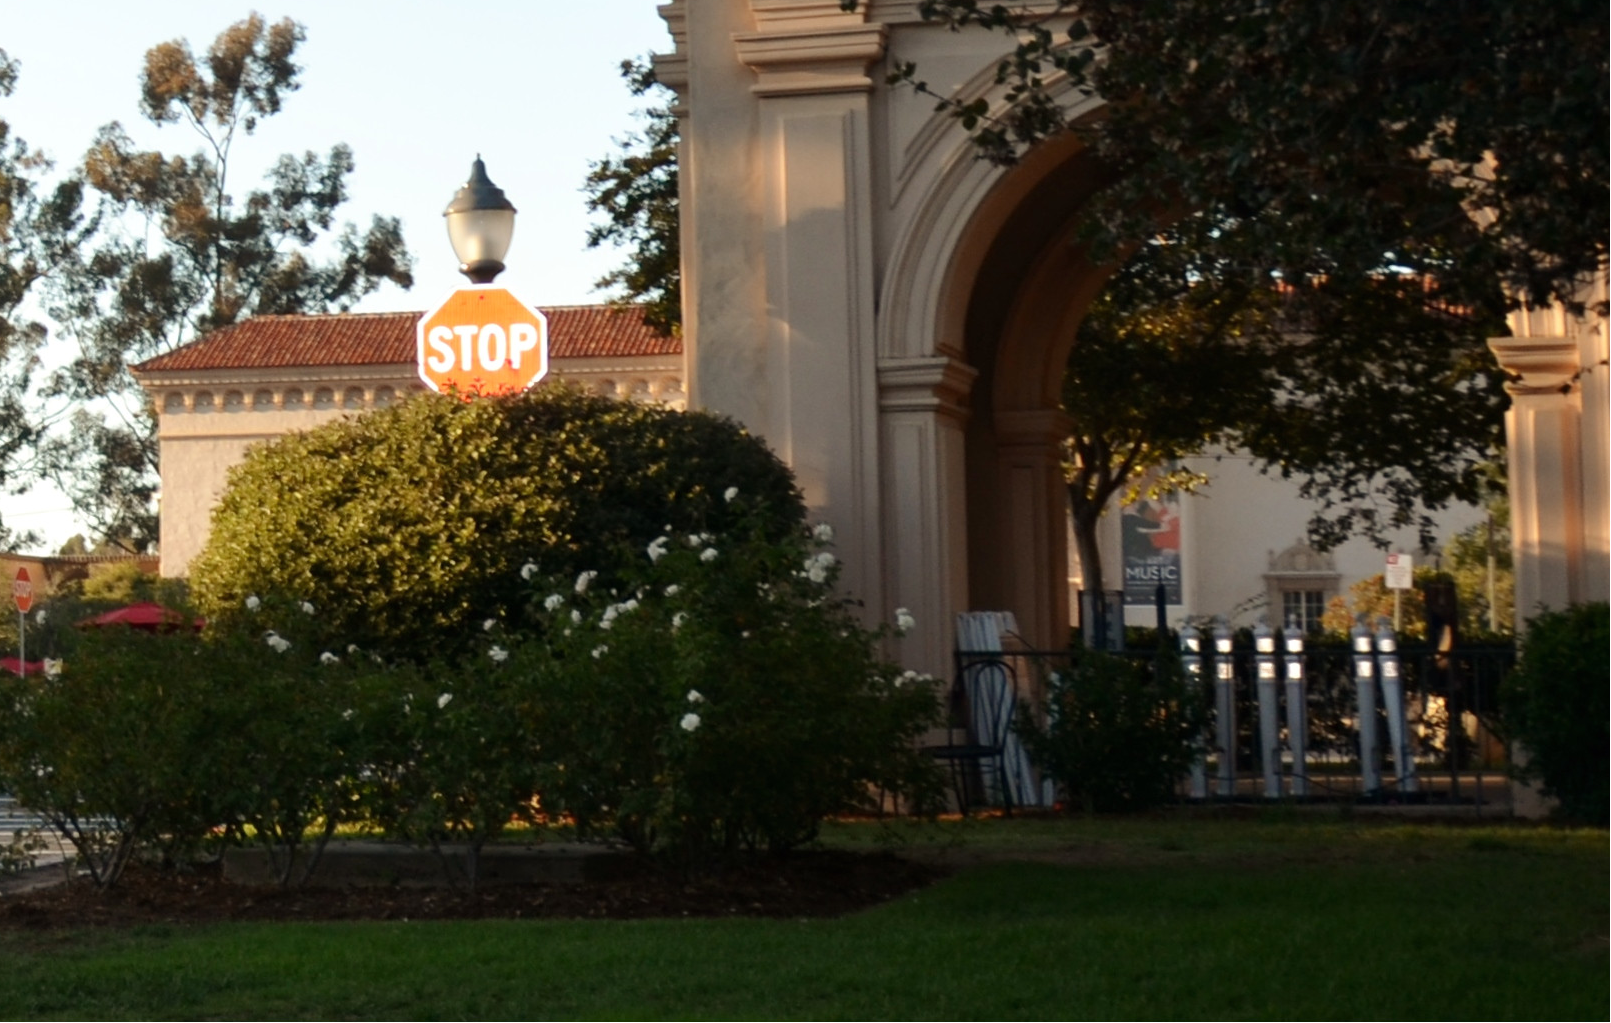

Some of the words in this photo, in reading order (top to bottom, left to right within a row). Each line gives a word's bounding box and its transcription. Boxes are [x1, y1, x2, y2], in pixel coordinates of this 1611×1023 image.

[427, 323, 538, 374] STOP
[1126, 565, 1178, 580] MUSIC
[14, 580, 32, 597] STOP
